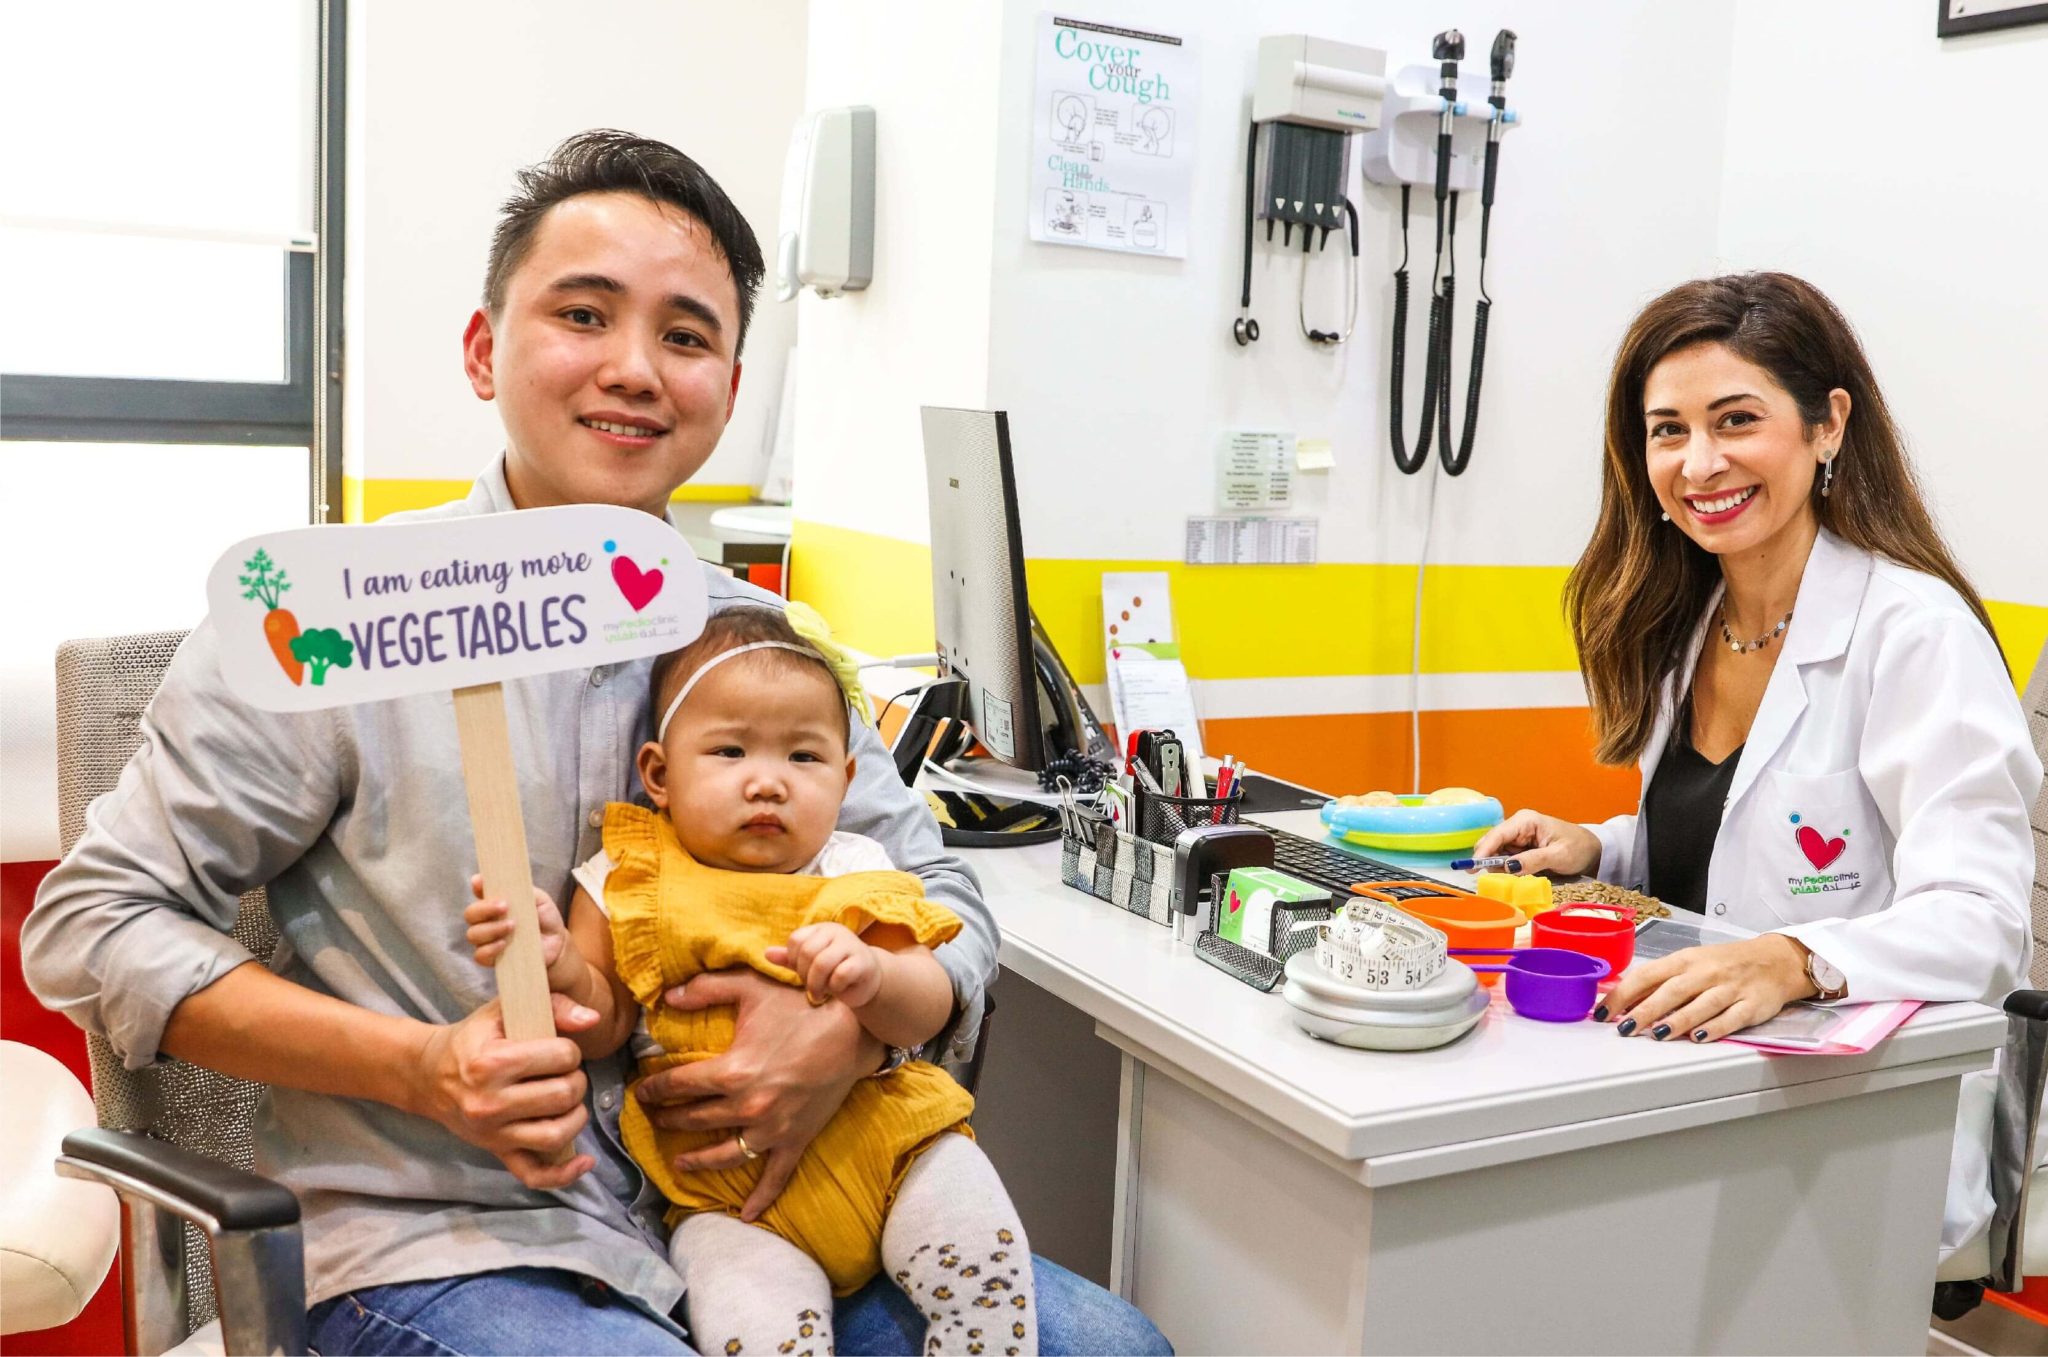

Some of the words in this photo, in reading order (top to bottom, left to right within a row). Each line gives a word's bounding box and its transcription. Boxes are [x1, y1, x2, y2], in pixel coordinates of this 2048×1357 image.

[1055, 28, 1141, 66] Cover
[1089, 63, 1170, 104] Cough
[1107, 63, 1141, 78] your
[1048, 154, 1090, 174] Clean
[1063, 171, 1110, 192] Hands
[343, 567, 352, 600] I
[363, 573, 412, 596] am
[420, 559, 514, 594] eating
[521, 551, 593, 579] more
[349, 593, 588, 671] VEGETABLES
[1367, 969, 1389, 985] 53
[1405, 968, 1421, 985] 54
